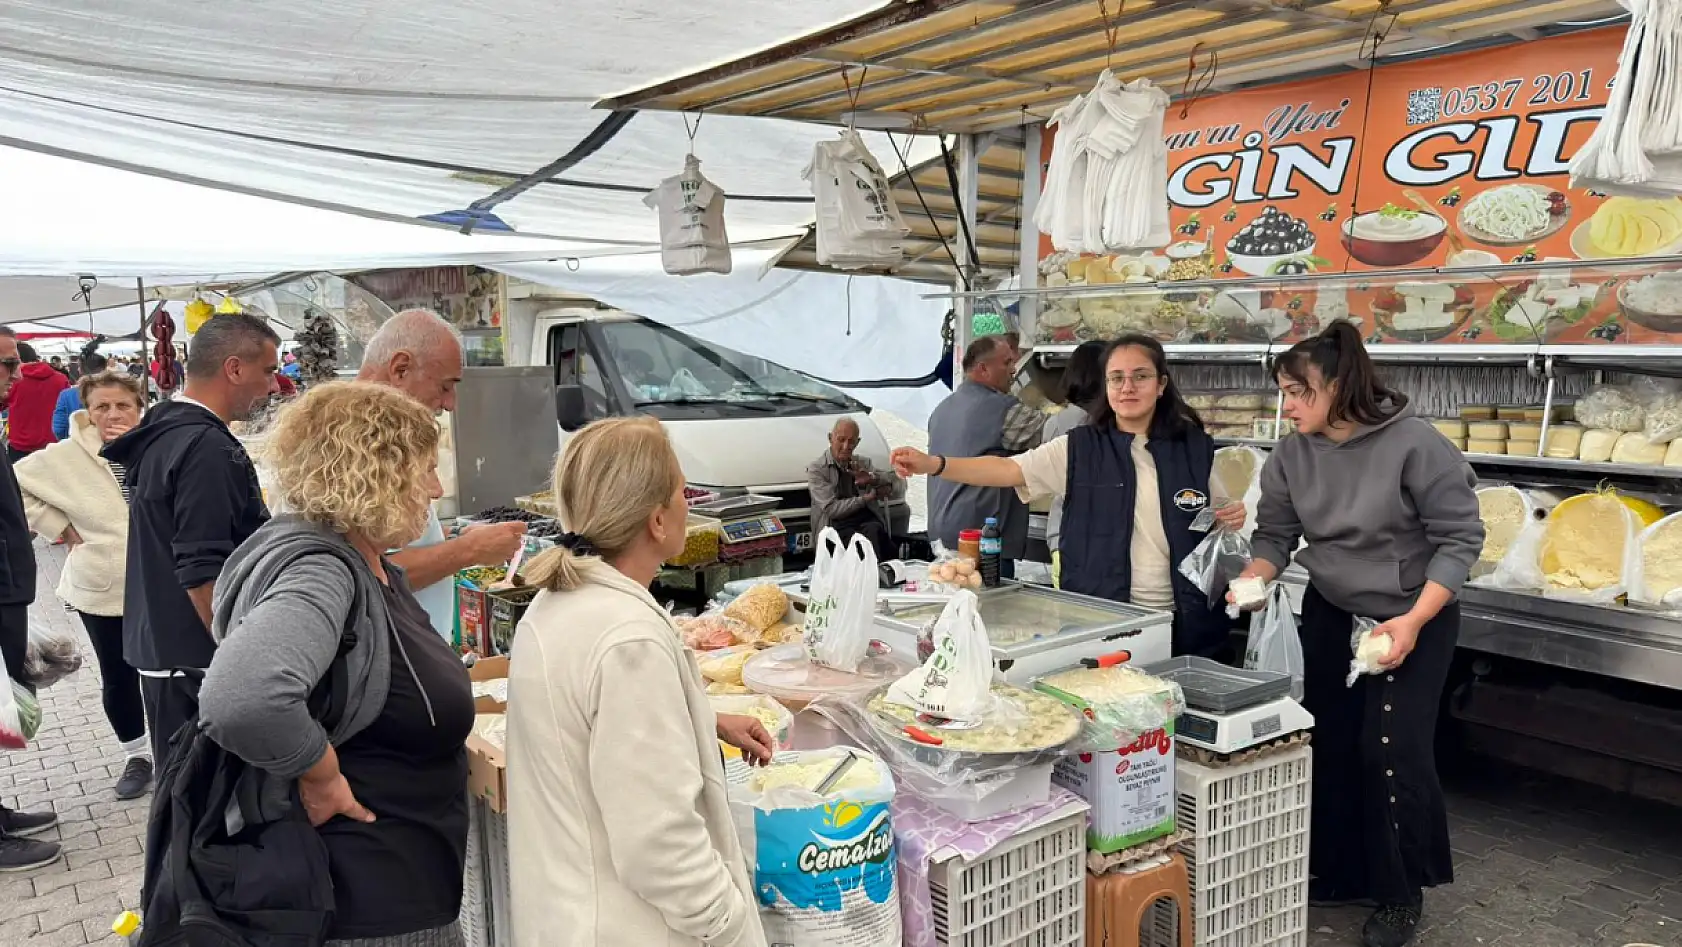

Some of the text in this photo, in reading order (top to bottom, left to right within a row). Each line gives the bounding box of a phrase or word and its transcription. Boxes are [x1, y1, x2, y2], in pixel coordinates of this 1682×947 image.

[1442, 78, 1523, 117] 0537
[1529, 68, 1592, 106] 201
[1263, 98, 1351, 142] Yeri
[1167, 104, 1607, 207] GİN GID
[796, 533, 811, 548] 48
